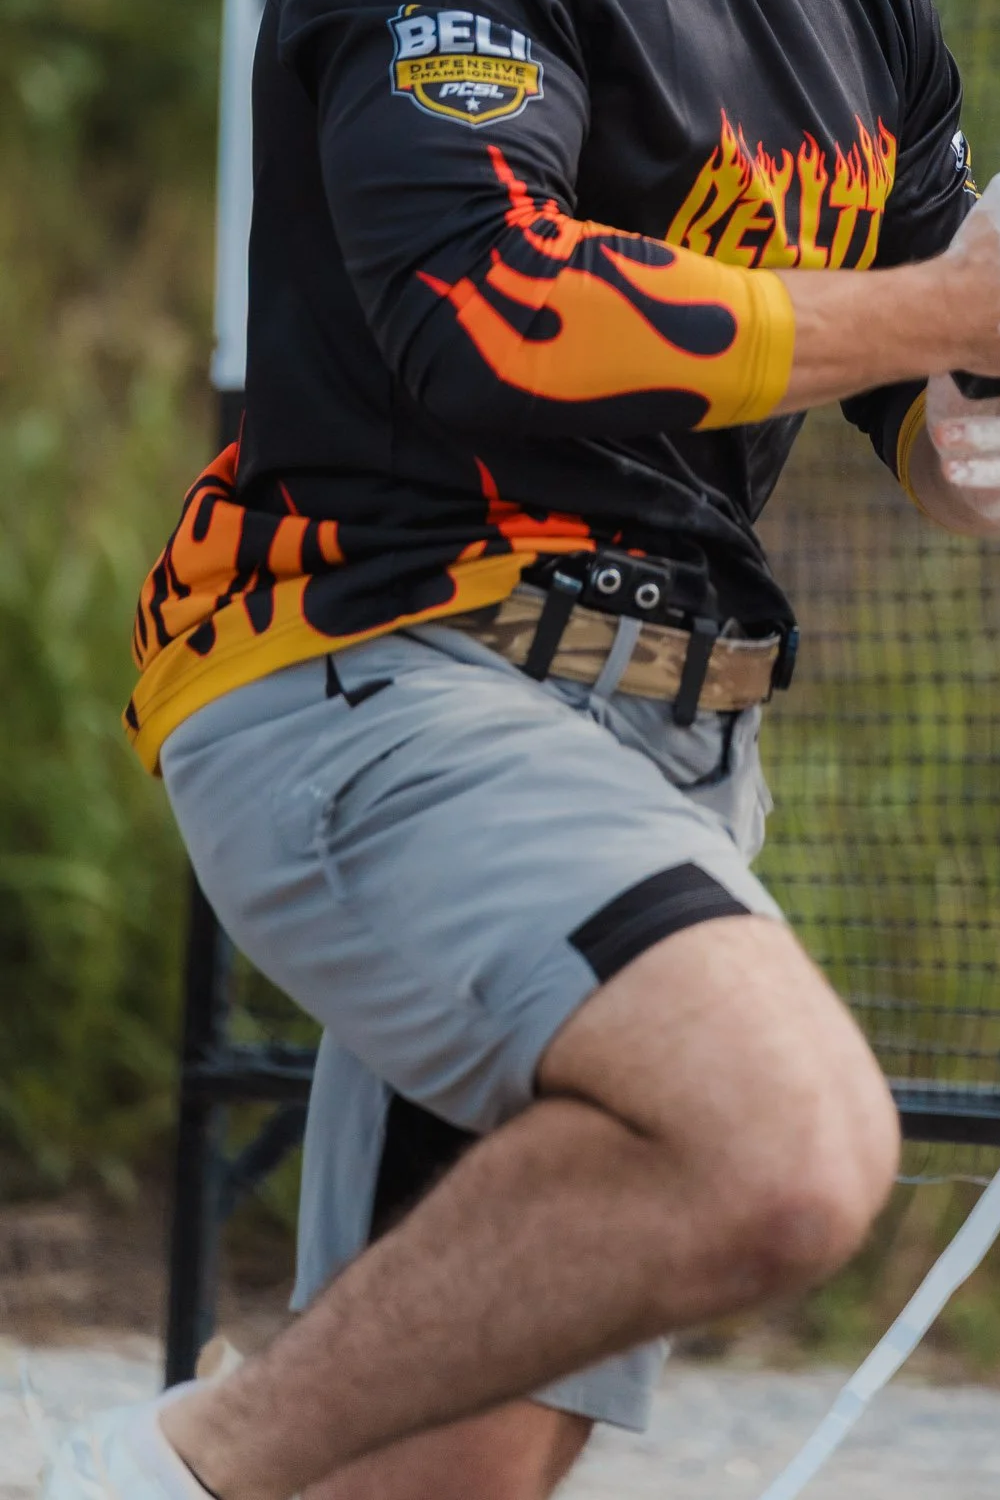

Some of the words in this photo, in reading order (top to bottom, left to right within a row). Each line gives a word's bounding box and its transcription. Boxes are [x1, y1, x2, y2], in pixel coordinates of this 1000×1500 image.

[410, 58, 526, 77] DEFENSIVE
[410, 69, 526, 85] CHAMPIONSHIP
[438, 82, 505, 100] PCSL
